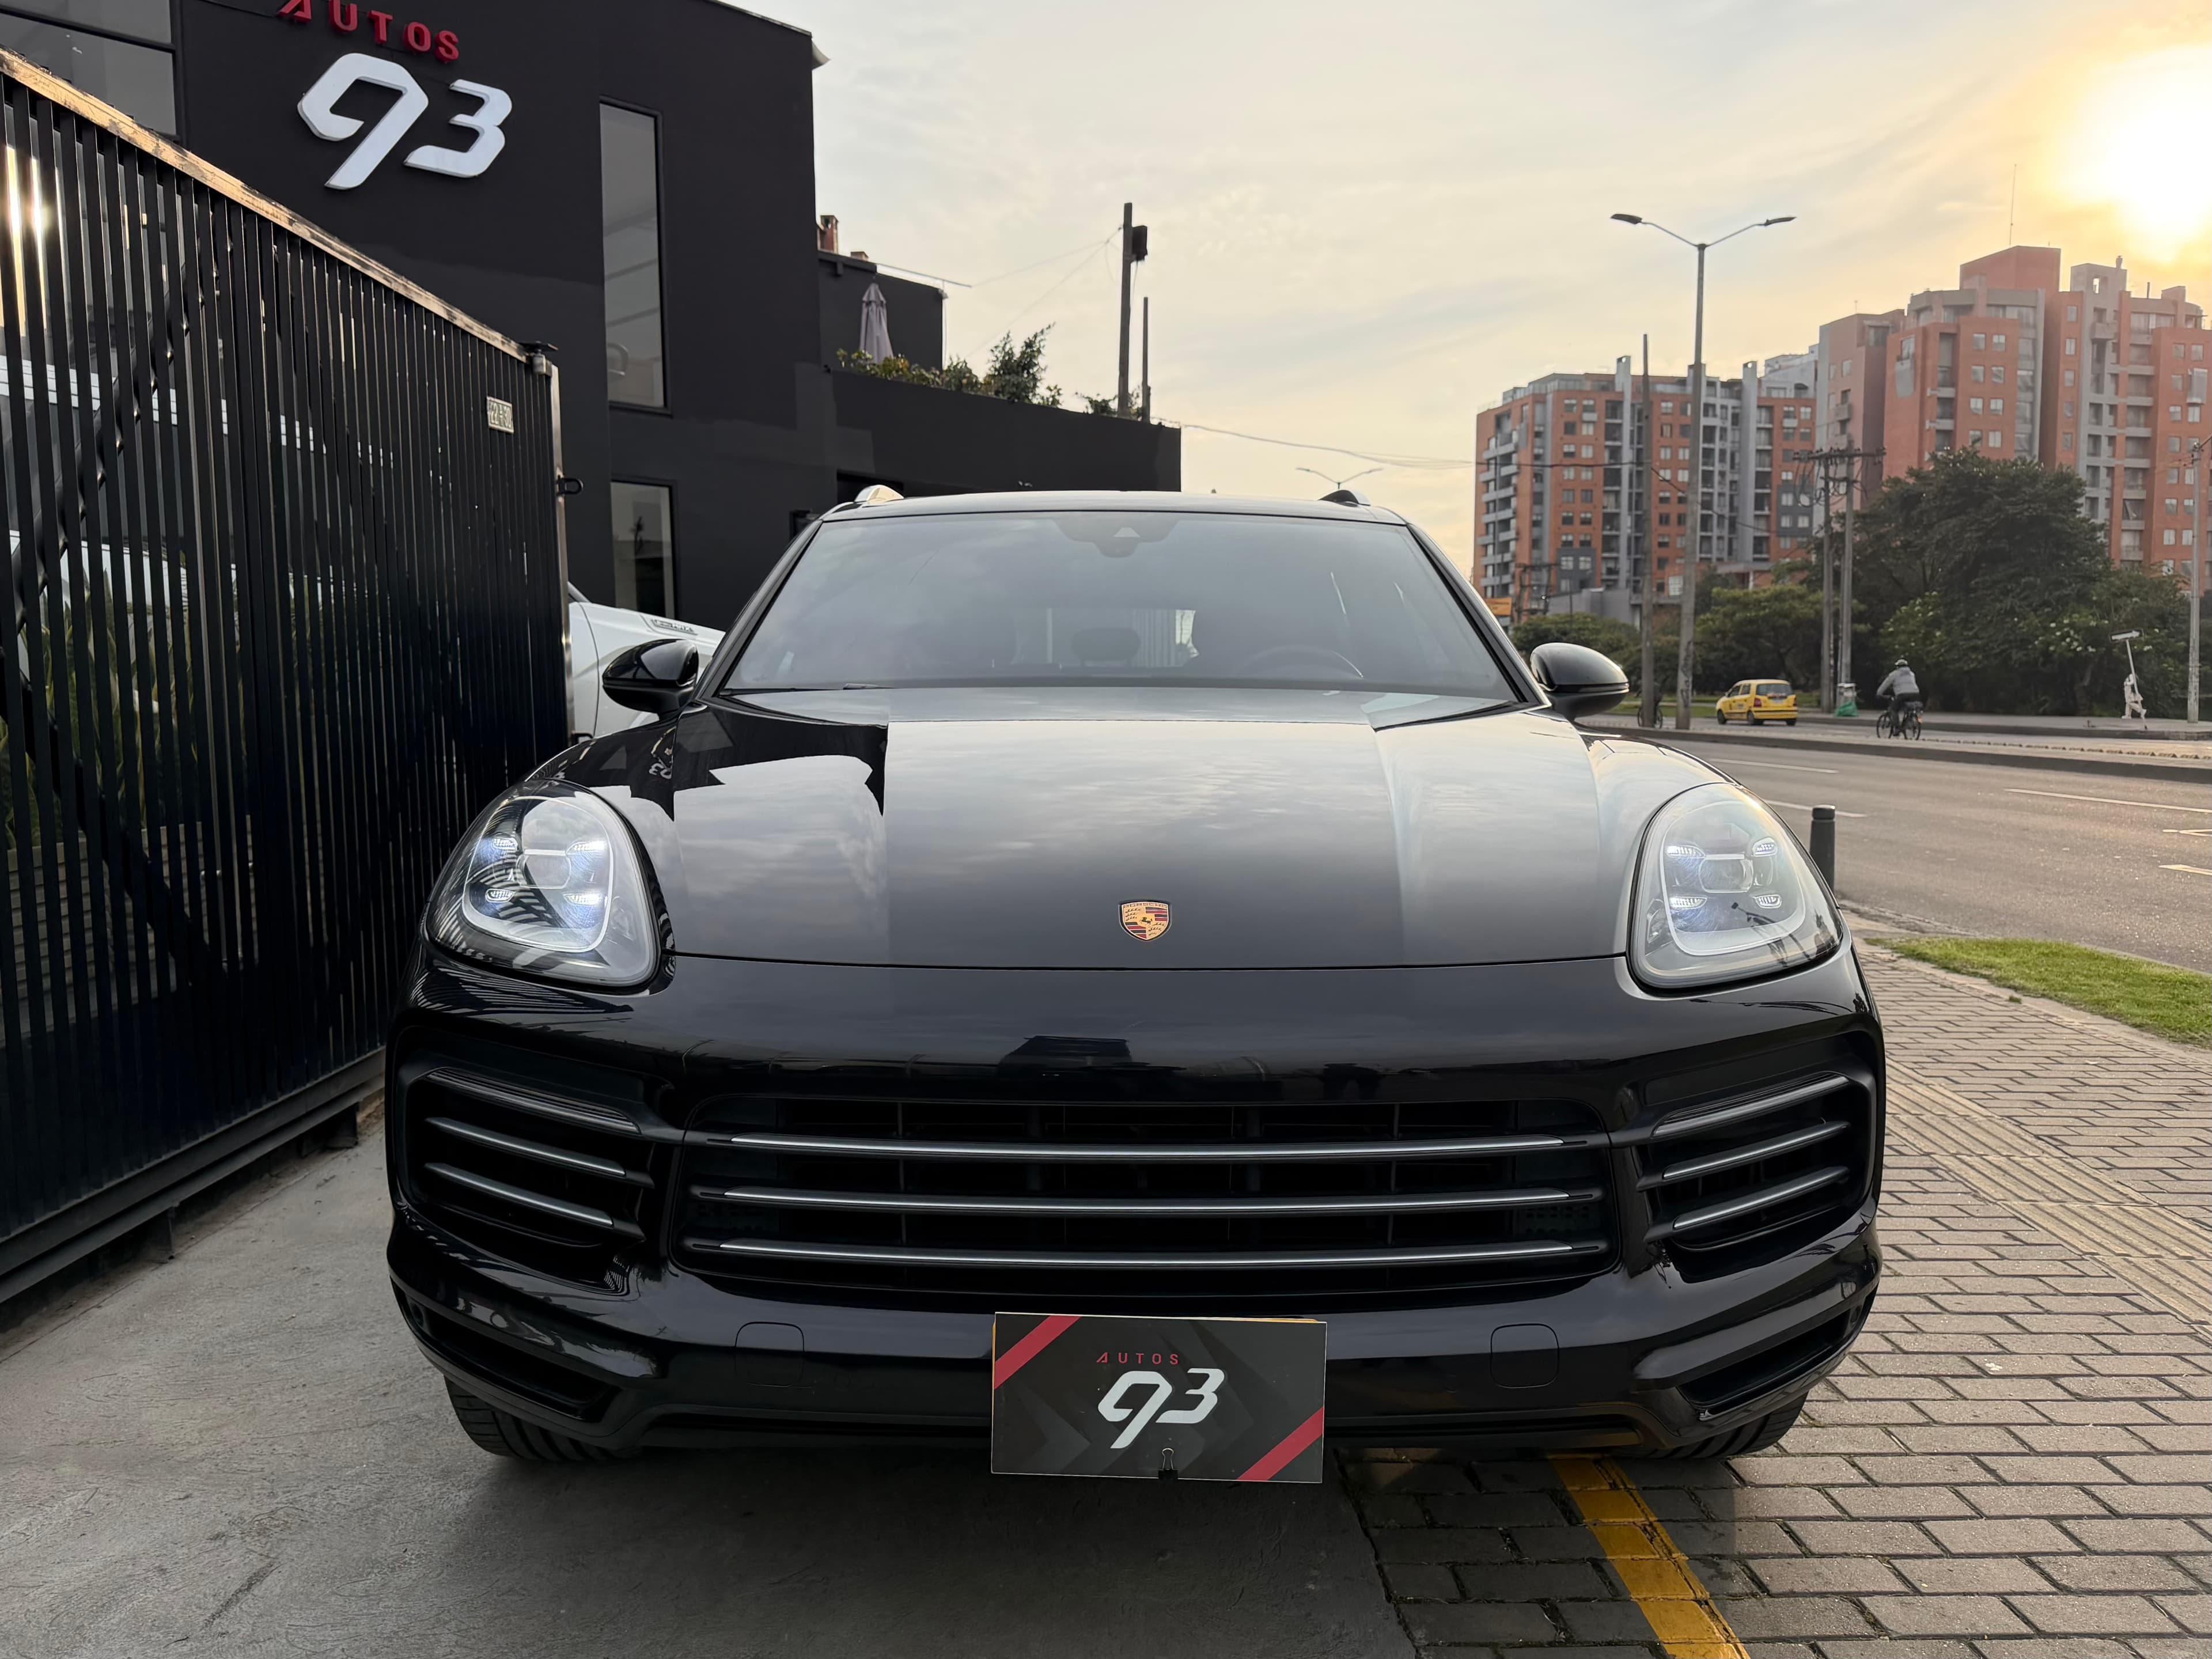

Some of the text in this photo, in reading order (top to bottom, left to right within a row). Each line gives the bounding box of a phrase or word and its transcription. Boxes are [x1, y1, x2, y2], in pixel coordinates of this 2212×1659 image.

[279, 0, 460, 63] AUTOS
[297, 52, 513, 190] 93
[1096, 1351, 1179, 1365] AUTOS
[1097, 1368, 1225, 1449] 93
